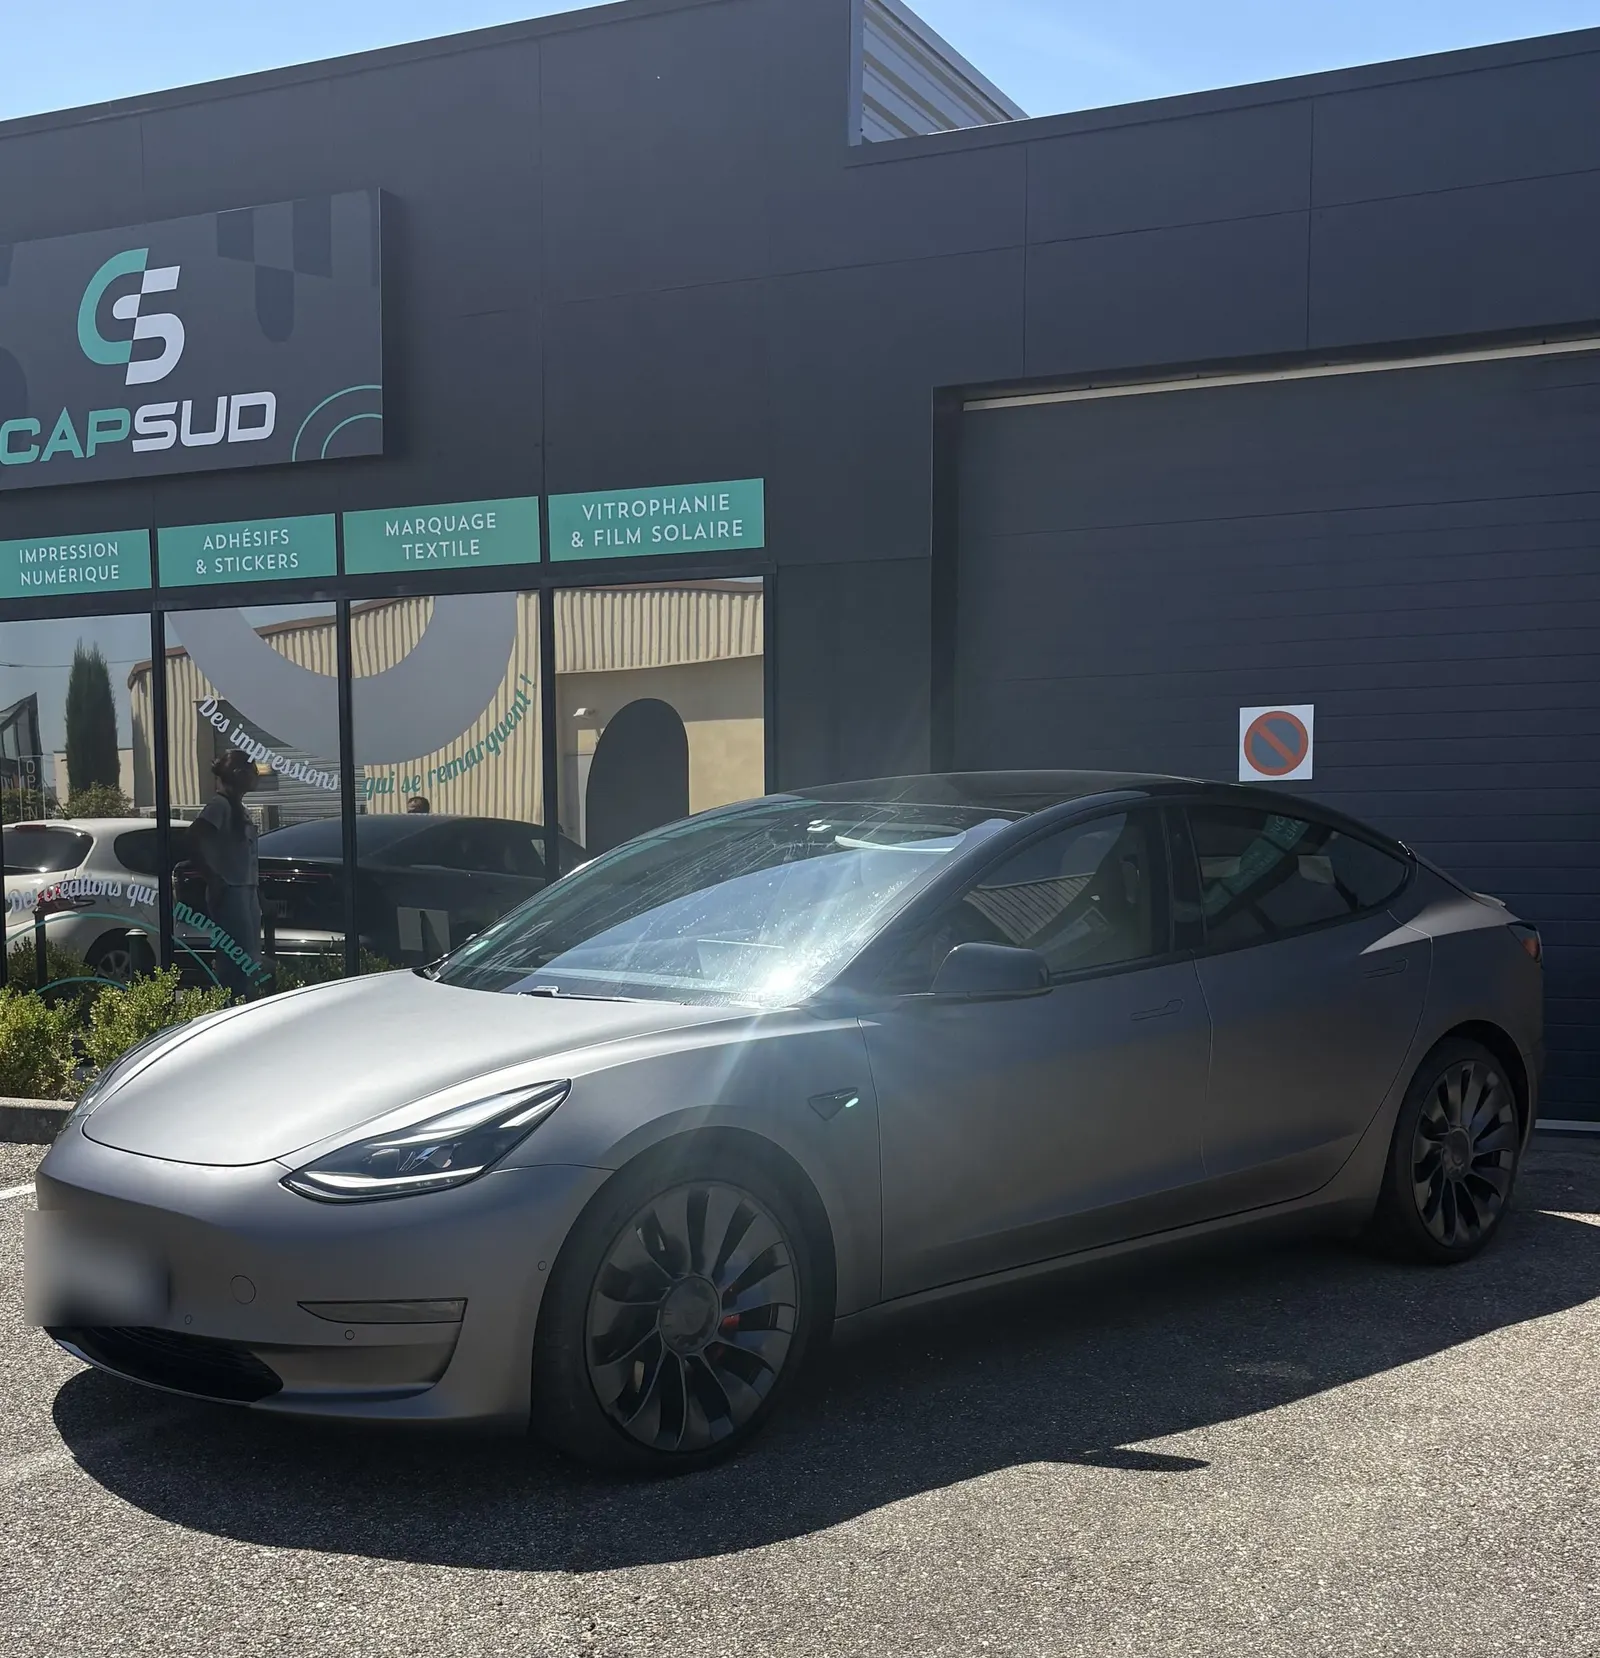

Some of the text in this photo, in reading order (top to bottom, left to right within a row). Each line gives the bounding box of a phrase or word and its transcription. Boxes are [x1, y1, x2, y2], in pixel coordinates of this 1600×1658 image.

[0, 391, 277, 465] CAPSUD
[582, 493, 730, 521] VITROPHANIE
[385, 512, 497, 537] MARQUAGE
[571, 519, 744, 548] & FILM SOLAIRE
[19, 541, 119, 564] IMPRESSION
[203, 528, 290, 551] ADHÉSIFS
[402, 539, 480, 560] TEXTILE
[20, 564, 120, 587] NUMÉRIQUE
[196, 552, 299, 574] & STICKERS
[198, 695, 340, 791] Des impressions
[362, 773, 395, 800] qui
[401, 776, 421, 793] se
[7, 872, 158, 912] Des créations qui
